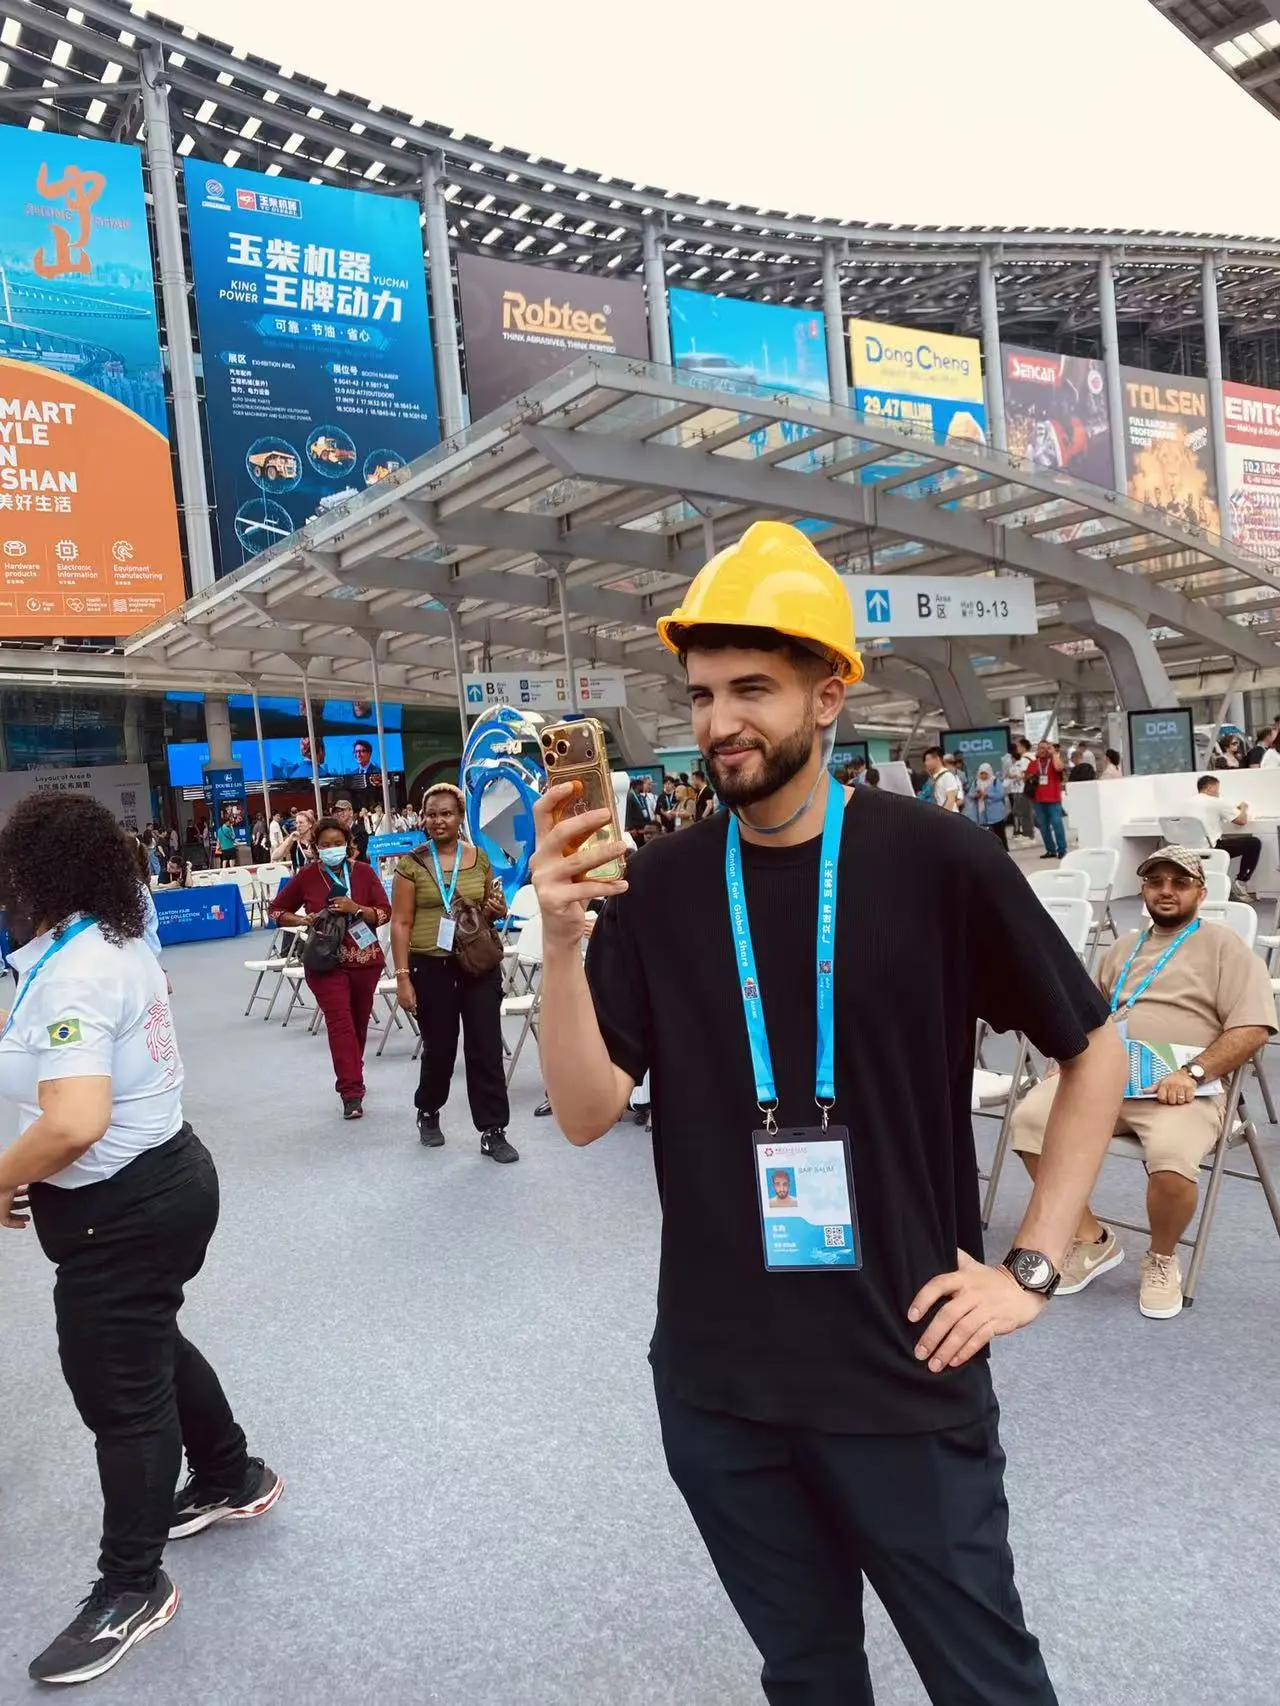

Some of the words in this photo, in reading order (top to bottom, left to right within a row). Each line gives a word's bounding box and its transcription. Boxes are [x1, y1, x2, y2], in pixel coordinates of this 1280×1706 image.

[227, 231, 370, 283] 玉柴机器
[231, 280, 257, 292] KING
[373, 275, 409, 289] YUCHAI
[219, 290, 258, 303] POWER
[264, 273, 403, 322] 王牌动力
[502, 332, 525, 341] THINK
[228, 353, 247, 364] 展区
[1125, 382, 1206, 417] TOLSEN
[1, 467, 77, 492] SHAN
[4, 562, 41, 571] Hardware
[57, 563, 92, 572] Electronic
[113, 564, 150, 573] Equipment
[5, 569, 37, 578] products
[58, 571, 98, 579] information
[114, 572, 164, 581] manufacturing
[935, 594, 951, 602] Area
[917, 593, 932, 618] B
[937, 603, 947, 619] 区
[976, 600, 1009, 618] 9-13
[486, 682, 495, 695] B
[35, 775, 60, 783] Layout
[729, 847, 737, 878] Canton
[731, 881, 739, 900] Fair
[158, 909, 179, 917] CANTON
[170, 912, 200, 920] COLLECTION
[733, 904, 745, 935] Global
[738, 940, 749, 968] Share
